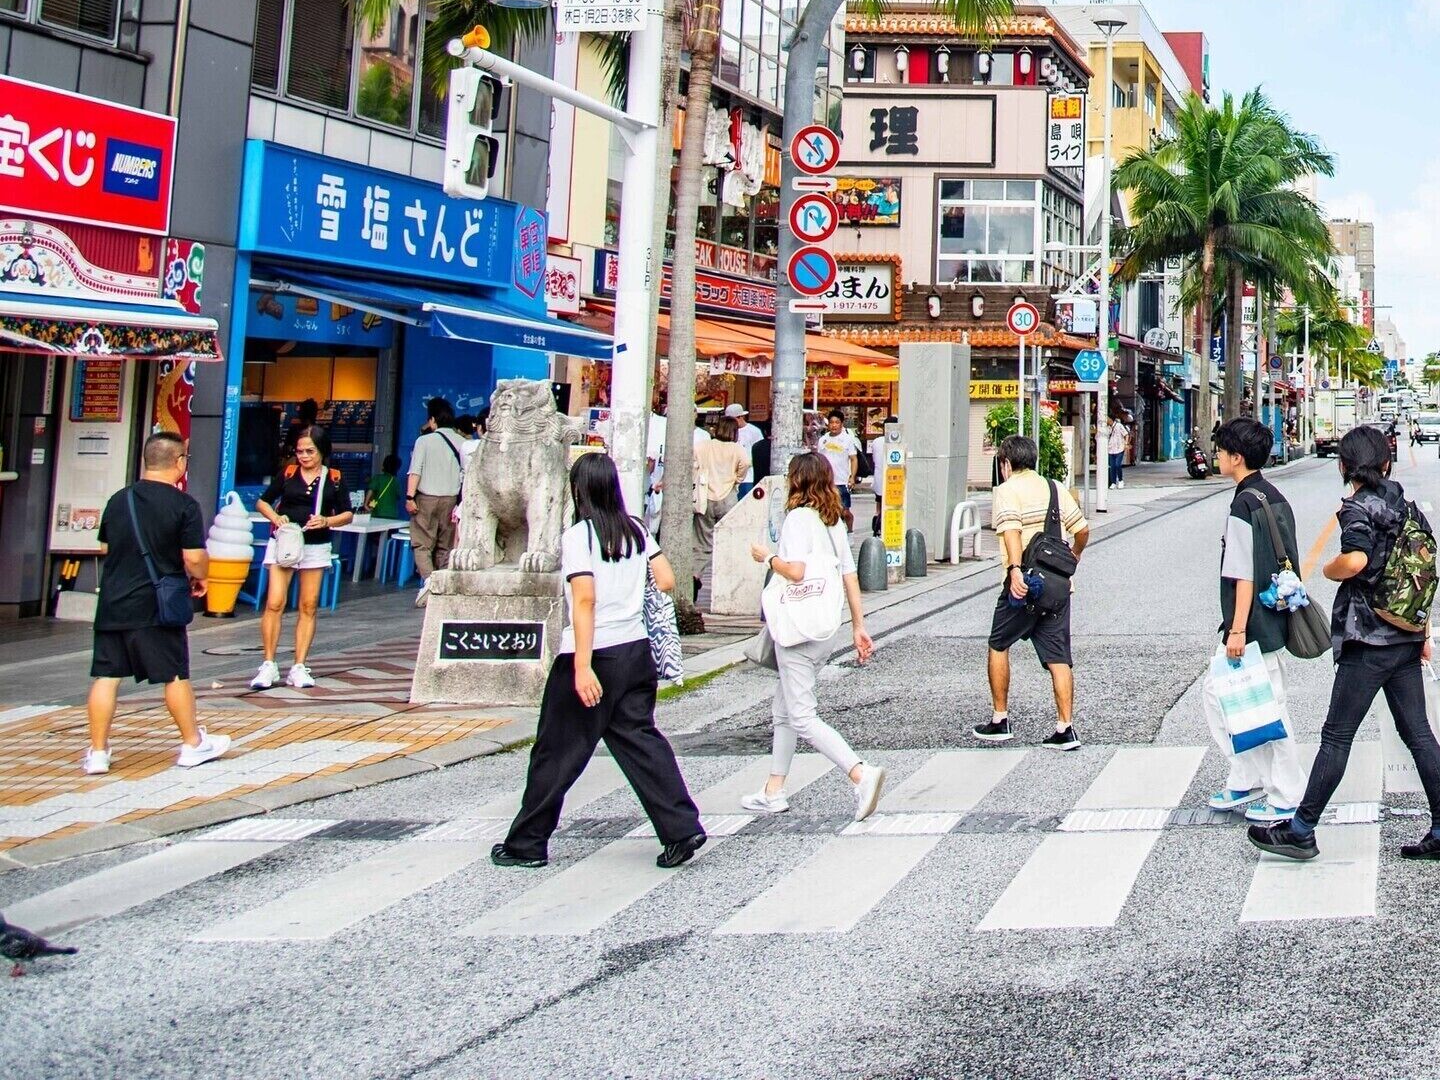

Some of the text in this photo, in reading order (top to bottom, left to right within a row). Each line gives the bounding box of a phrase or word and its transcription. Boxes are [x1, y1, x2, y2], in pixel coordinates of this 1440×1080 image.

[869, 105, 919, 156] 理
[0, 113, 96, 187] 宝くじ
[1050, 142, 1081, 160] ライブ
[111, 152, 157, 179] NUMBERS
[316, 173, 483, 268] 雪塩さんど
[833, 302, 878, 310] -917-1475
[1014, 312, 1033, 327] 30
[1080, 358, 1100, 372] 39
[445, 631, 537, 650] こくさいとおり
